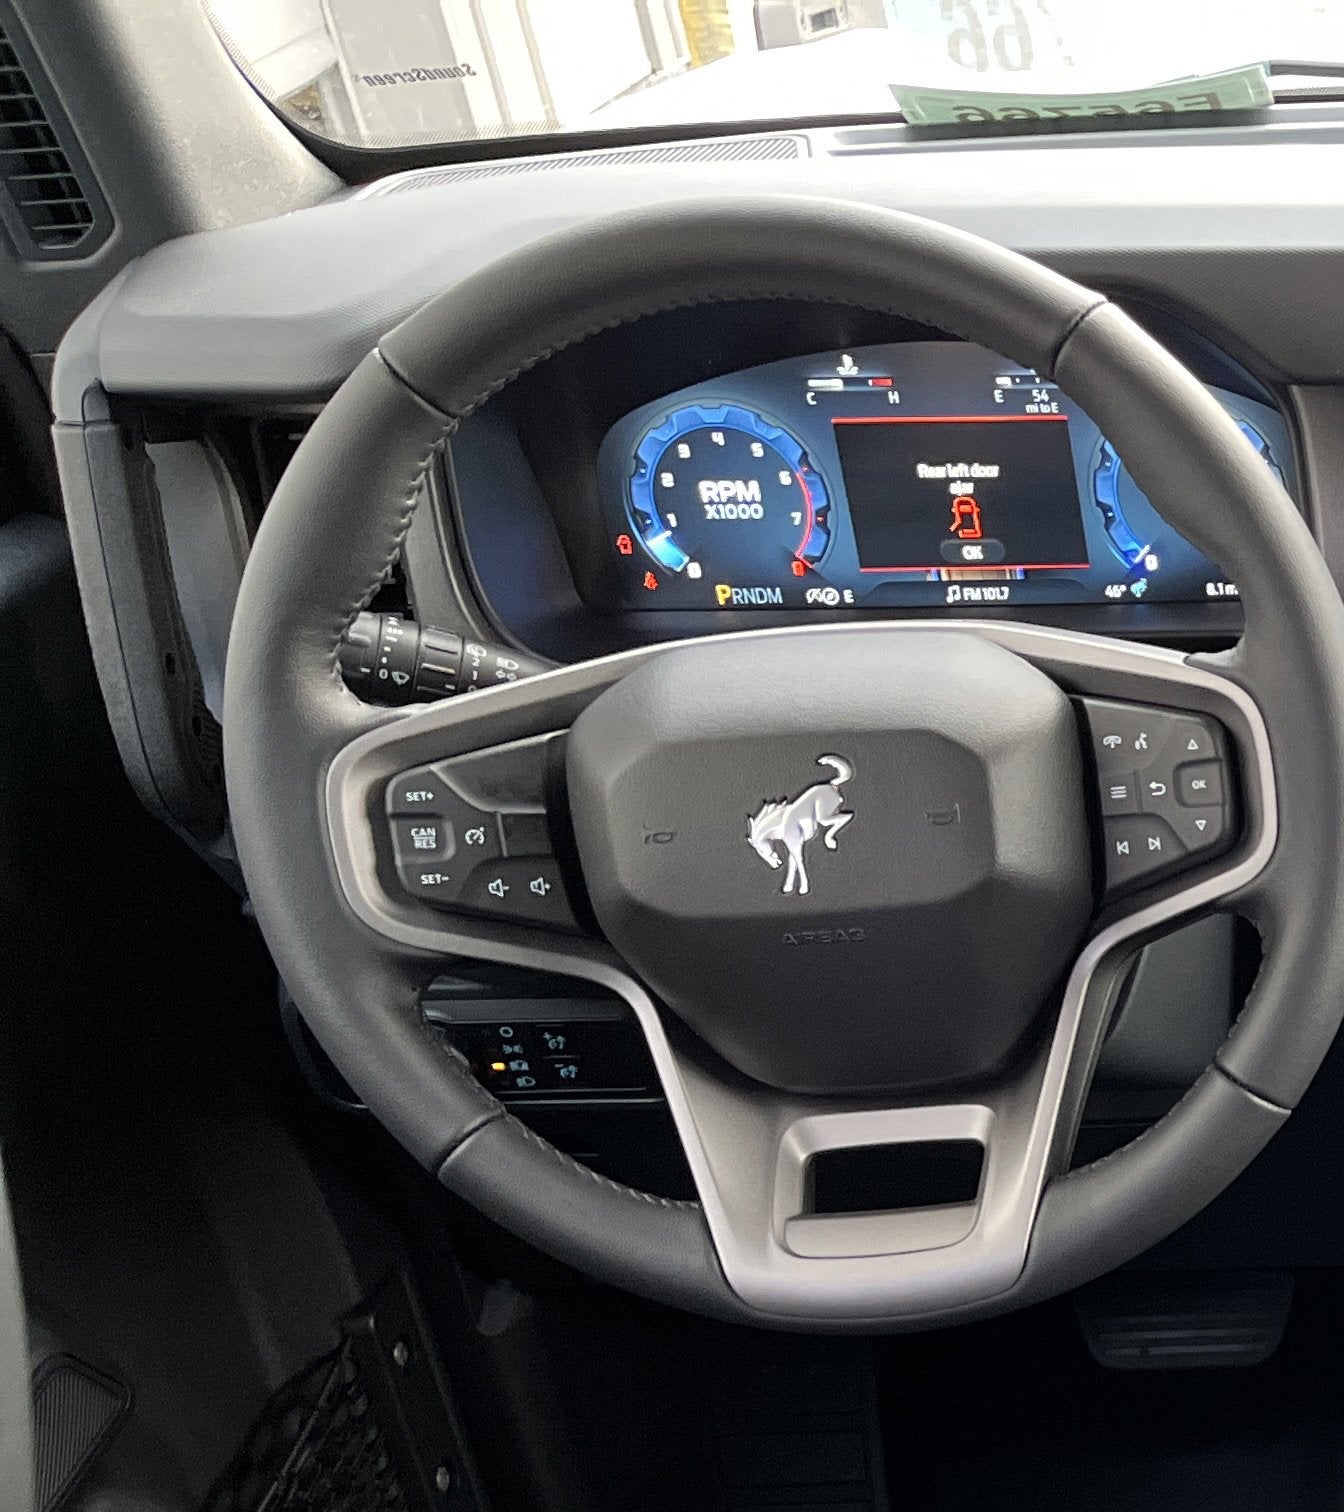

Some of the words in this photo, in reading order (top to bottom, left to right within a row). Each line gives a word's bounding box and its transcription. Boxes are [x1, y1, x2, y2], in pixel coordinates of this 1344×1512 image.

[806, 391, 817, 405] C
[888, 391, 900, 405] H
[993, 389, 1005, 404] E
[1031, 389, 1050, 402] 54
[711, 431, 726, 446] 4
[677, 443, 691, 459] 3
[750, 442, 764, 458] 5
[778, 470, 792, 486] 6
[917, 463, 946, 478] Rear
[947, 463, 970, 478] left
[970, 463, 999, 478] door
[660, 471, 675, 488] 2
[698, 480, 762, 503] RPM
[704, 503, 764, 520] X1000
[790, 511, 802, 526] 7
[666, 513, 677, 528] 1
[962, 545, 984, 560] OK
[1145, 554, 1158, 571] 0
[686, 562, 702, 579] 0
[715, 584, 784, 607] PRNDM
[963, 587, 982, 601] FM
[1191, 779, 1207, 790] OK
[405, 790, 434, 801] SET+
[410, 827, 437, 839] CAN
[413, 838, 437, 850] RES
